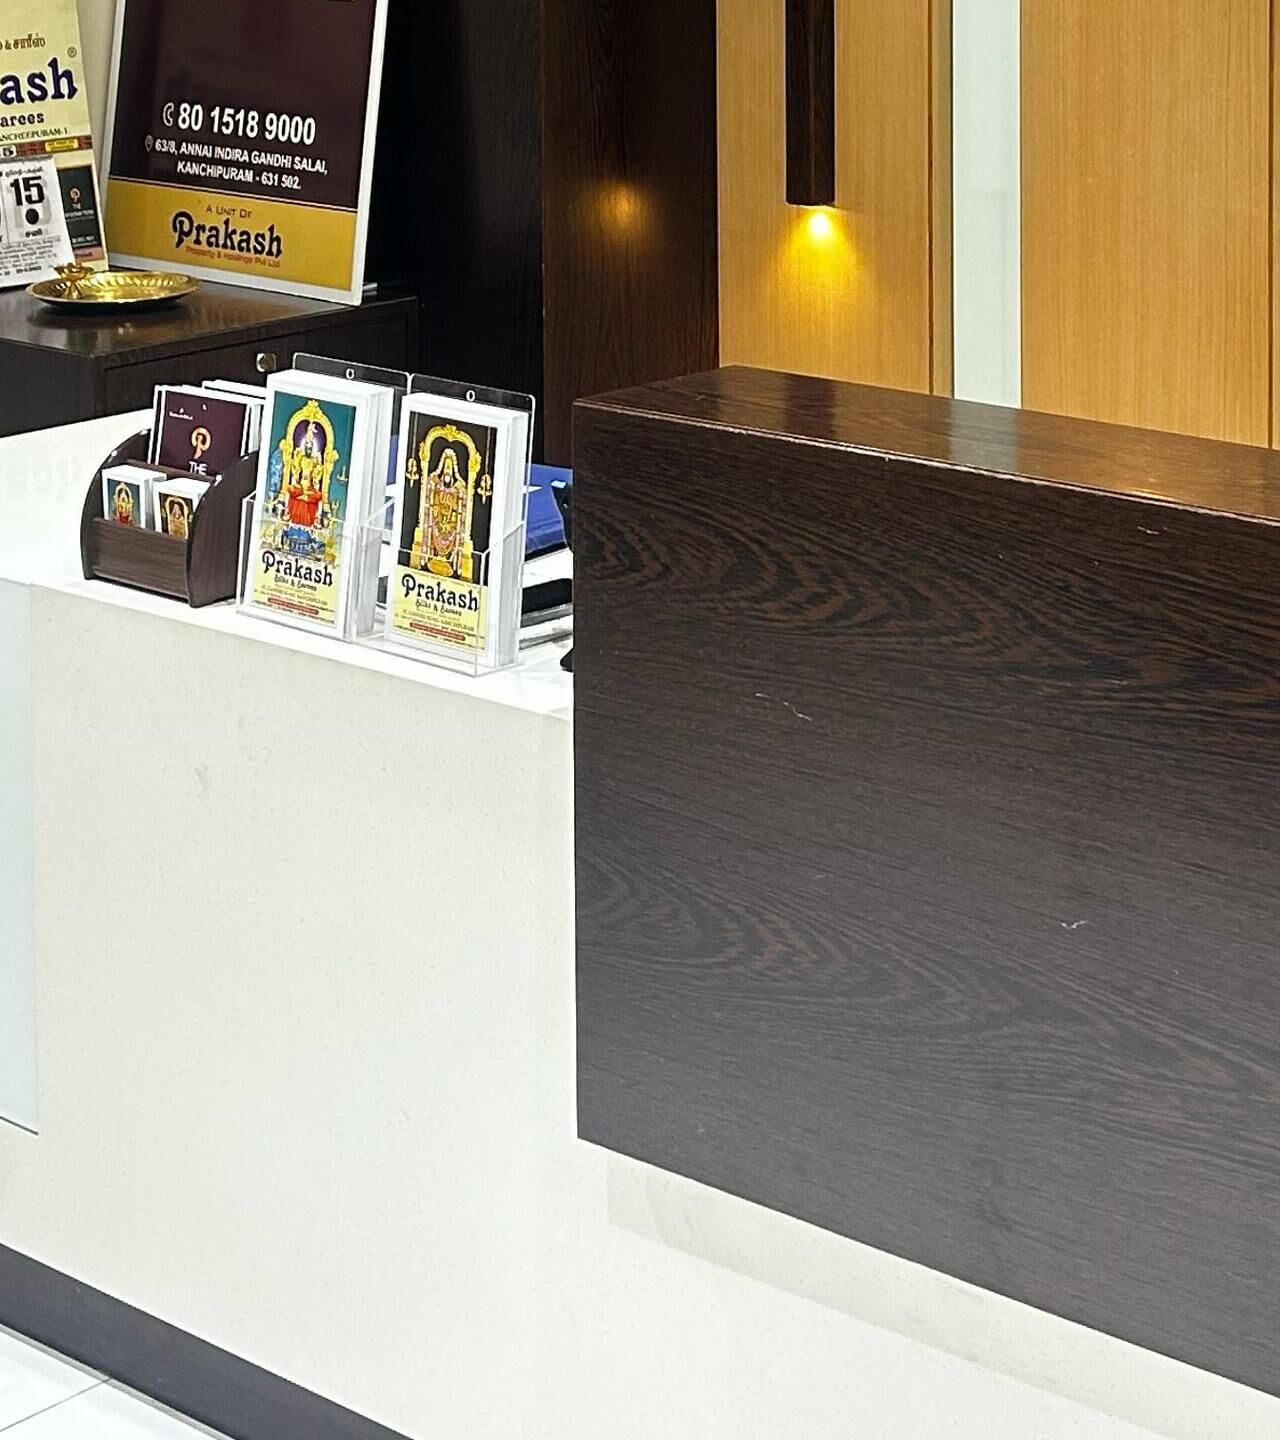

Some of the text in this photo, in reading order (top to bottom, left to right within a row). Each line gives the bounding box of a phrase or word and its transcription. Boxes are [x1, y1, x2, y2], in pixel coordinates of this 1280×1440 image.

[178, 102, 316, 146] 80 1518 9000
[177, 160, 253, 183] KANCHIPURAM
[261, 171, 279, 187] 631
[179, 142, 212, 158] ANNAI
[214, 146, 249, 163] INDIRA
[251, 151, 292, 169] GANDHI
[293, 156, 328, 175] SALAI,
[10, 175, 45, 206] 15
[206, 204, 212, 213] A
[172, 210, 282, 259] Prakash
[189, 461, 208, 476] THE
[262, 550, 333, 587] Prakash
[401, 573, 479, 612] Prakash
